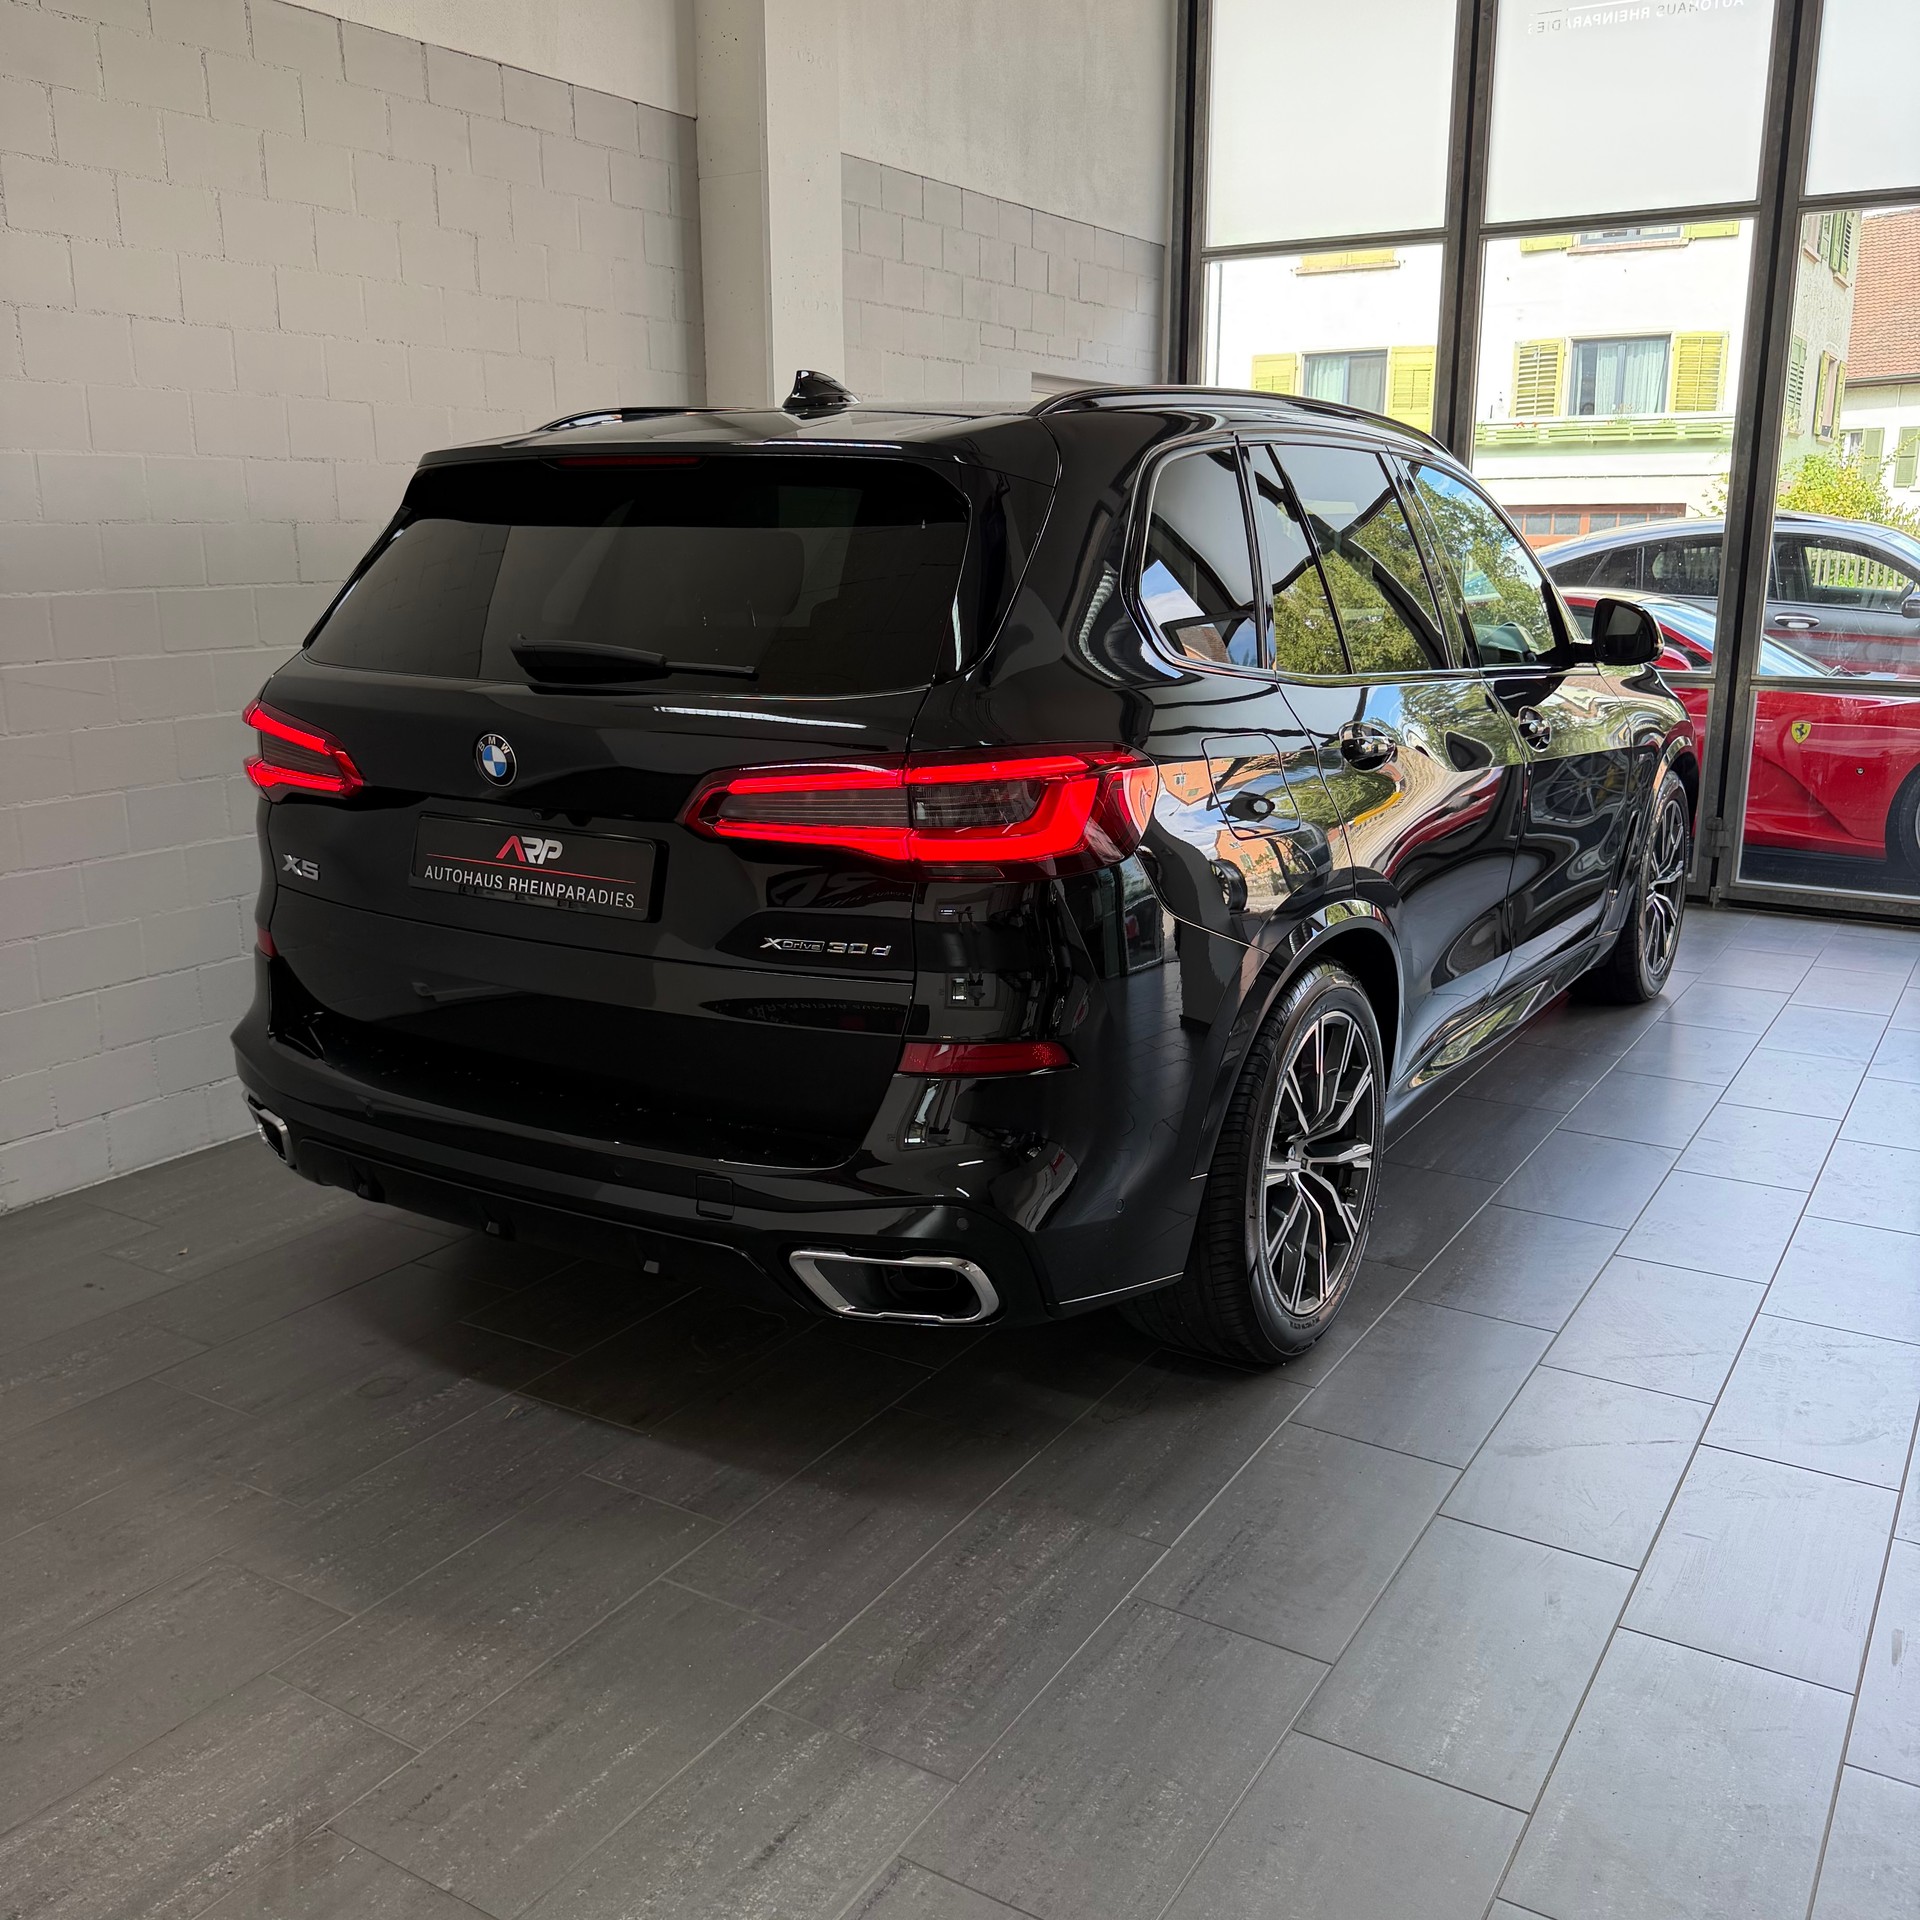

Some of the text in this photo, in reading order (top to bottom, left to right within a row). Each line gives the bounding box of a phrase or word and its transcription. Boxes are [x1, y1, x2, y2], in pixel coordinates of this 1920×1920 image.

[479, 737, 510, 754] BMW
[495, 834, 563, 864] ARP
[282, 854, 319, 881] X5
[424, 865, 635, 909] AUTOHAUS RHEINPARADIES
